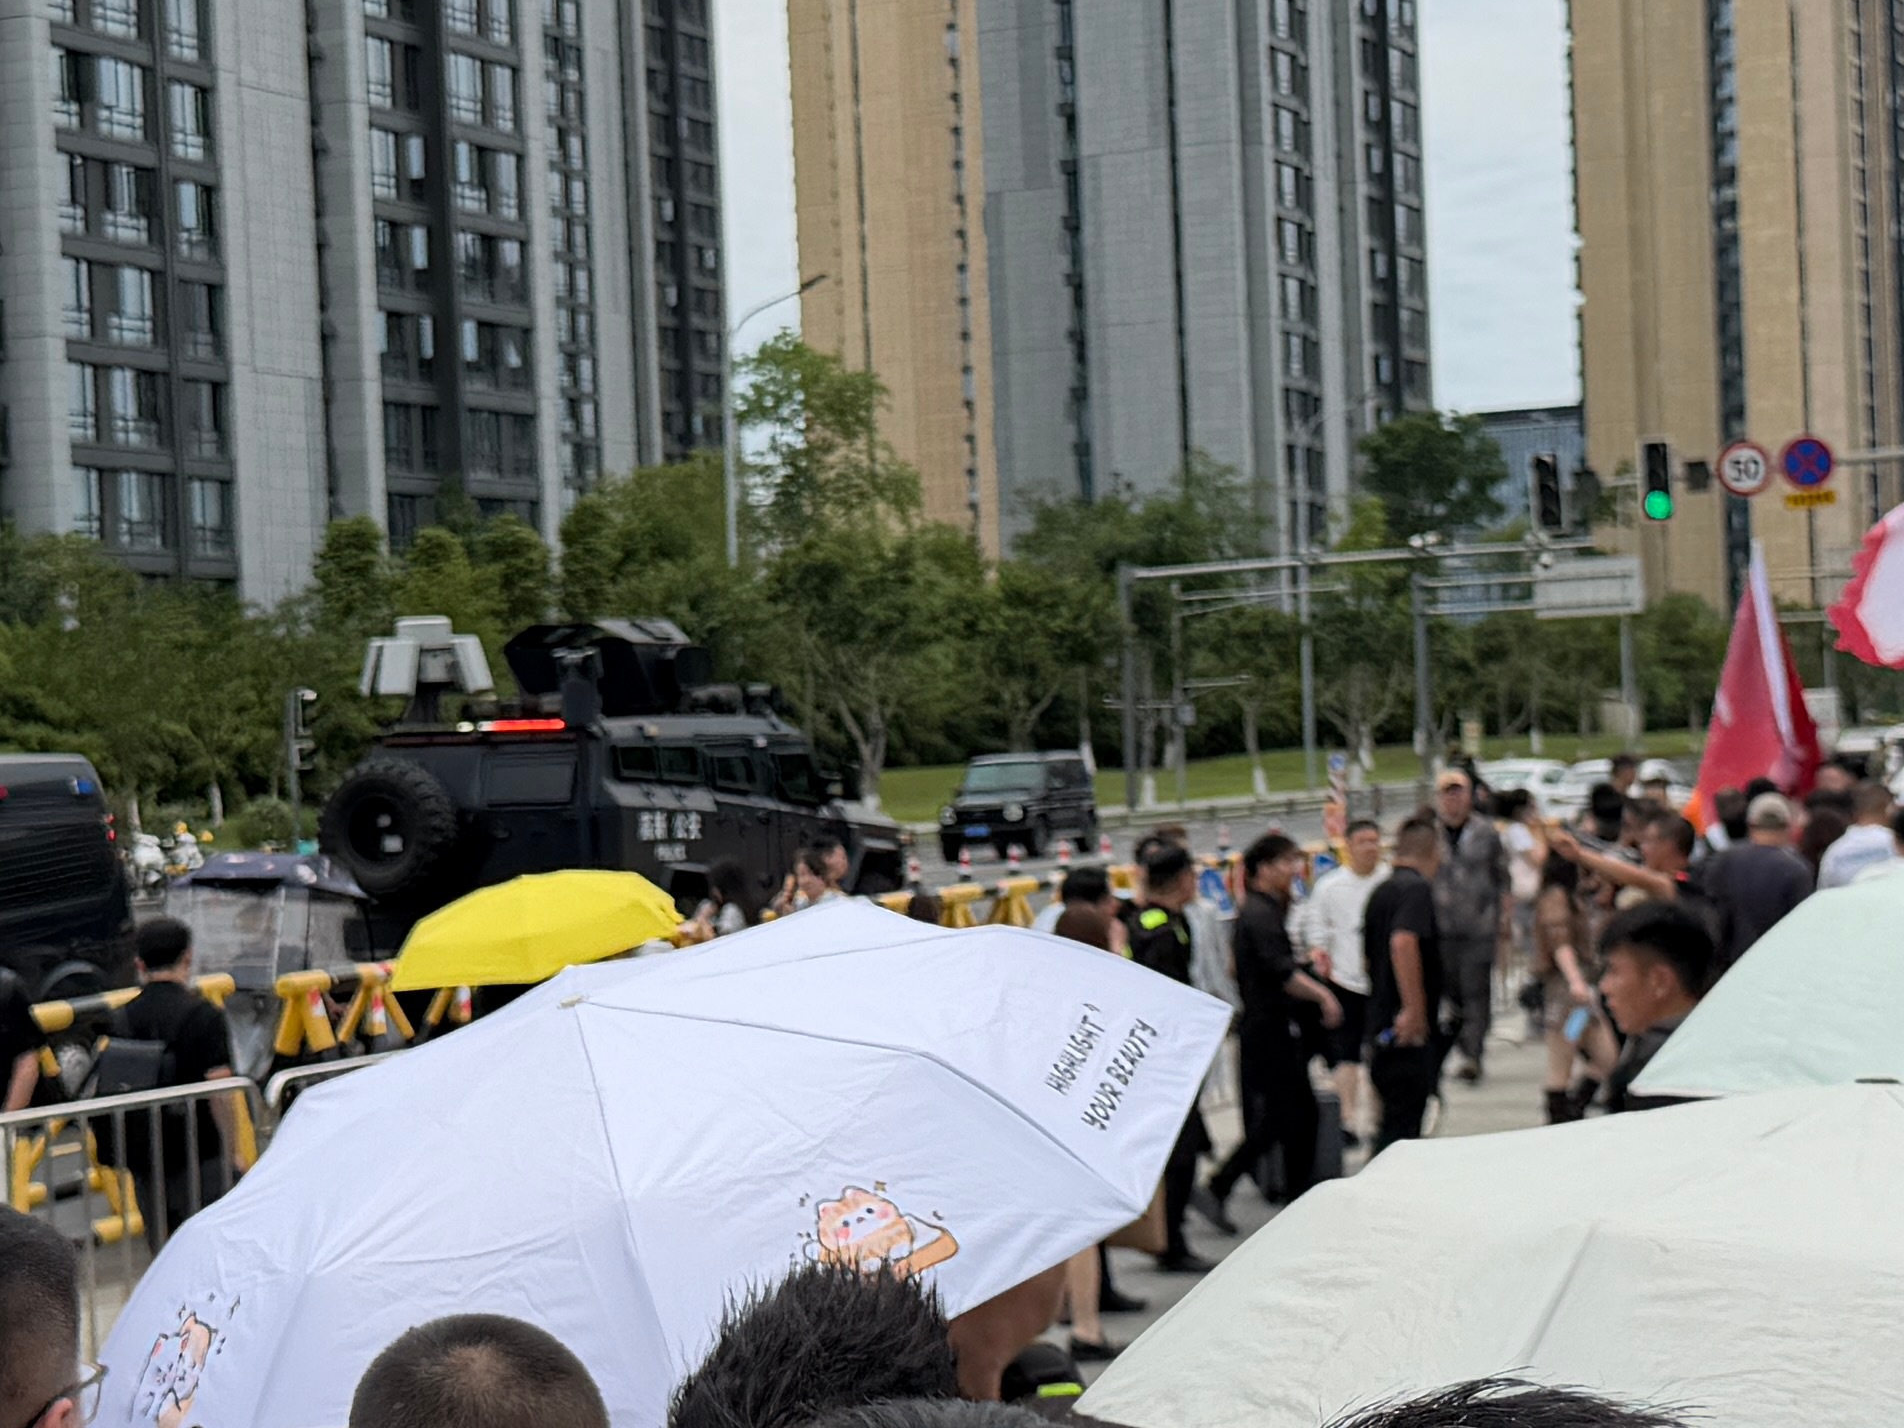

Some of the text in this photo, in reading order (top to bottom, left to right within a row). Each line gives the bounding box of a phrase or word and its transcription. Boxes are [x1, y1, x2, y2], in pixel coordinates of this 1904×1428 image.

[1730, 455, 1759, 483] 50
[1080, 1018, 1157, 1131] YOUR BEAUTY
